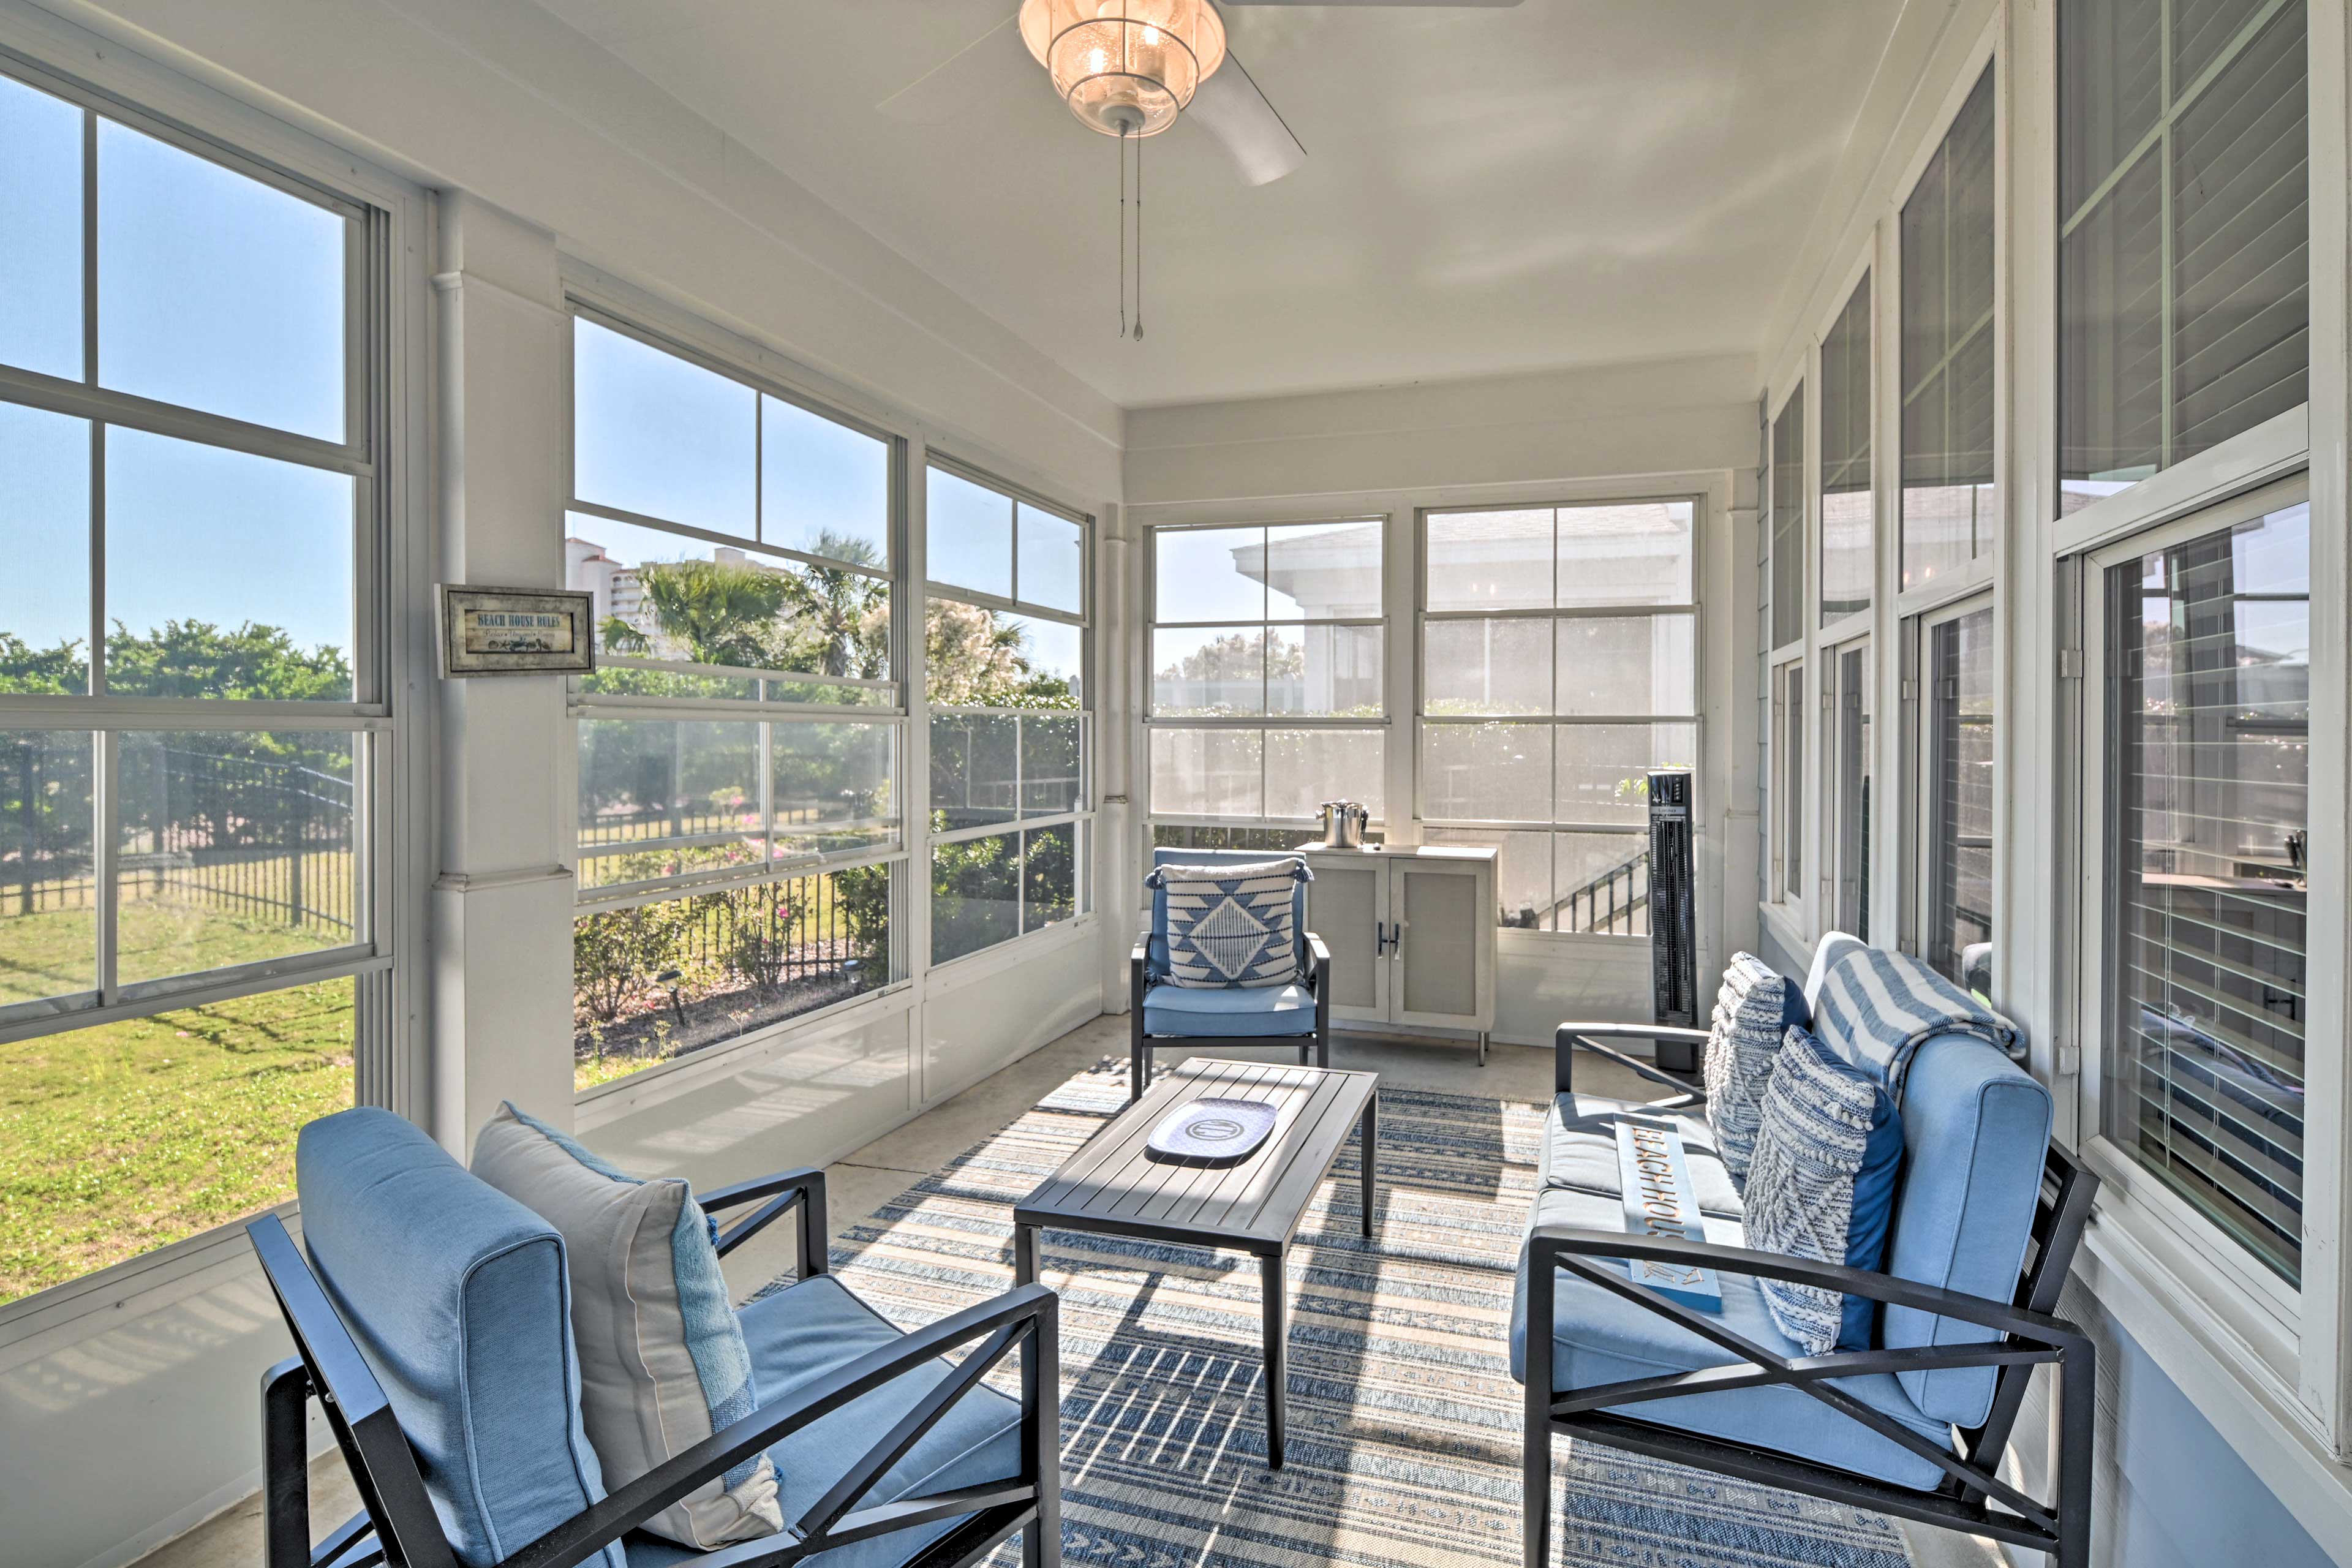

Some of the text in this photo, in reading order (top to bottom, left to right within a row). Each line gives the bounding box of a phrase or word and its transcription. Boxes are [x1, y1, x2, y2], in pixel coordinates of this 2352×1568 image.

[478, 614, 560, 627] BEACH HOUSE RULES
[1632, 1127, 1686, 1238] BEACH HOU
